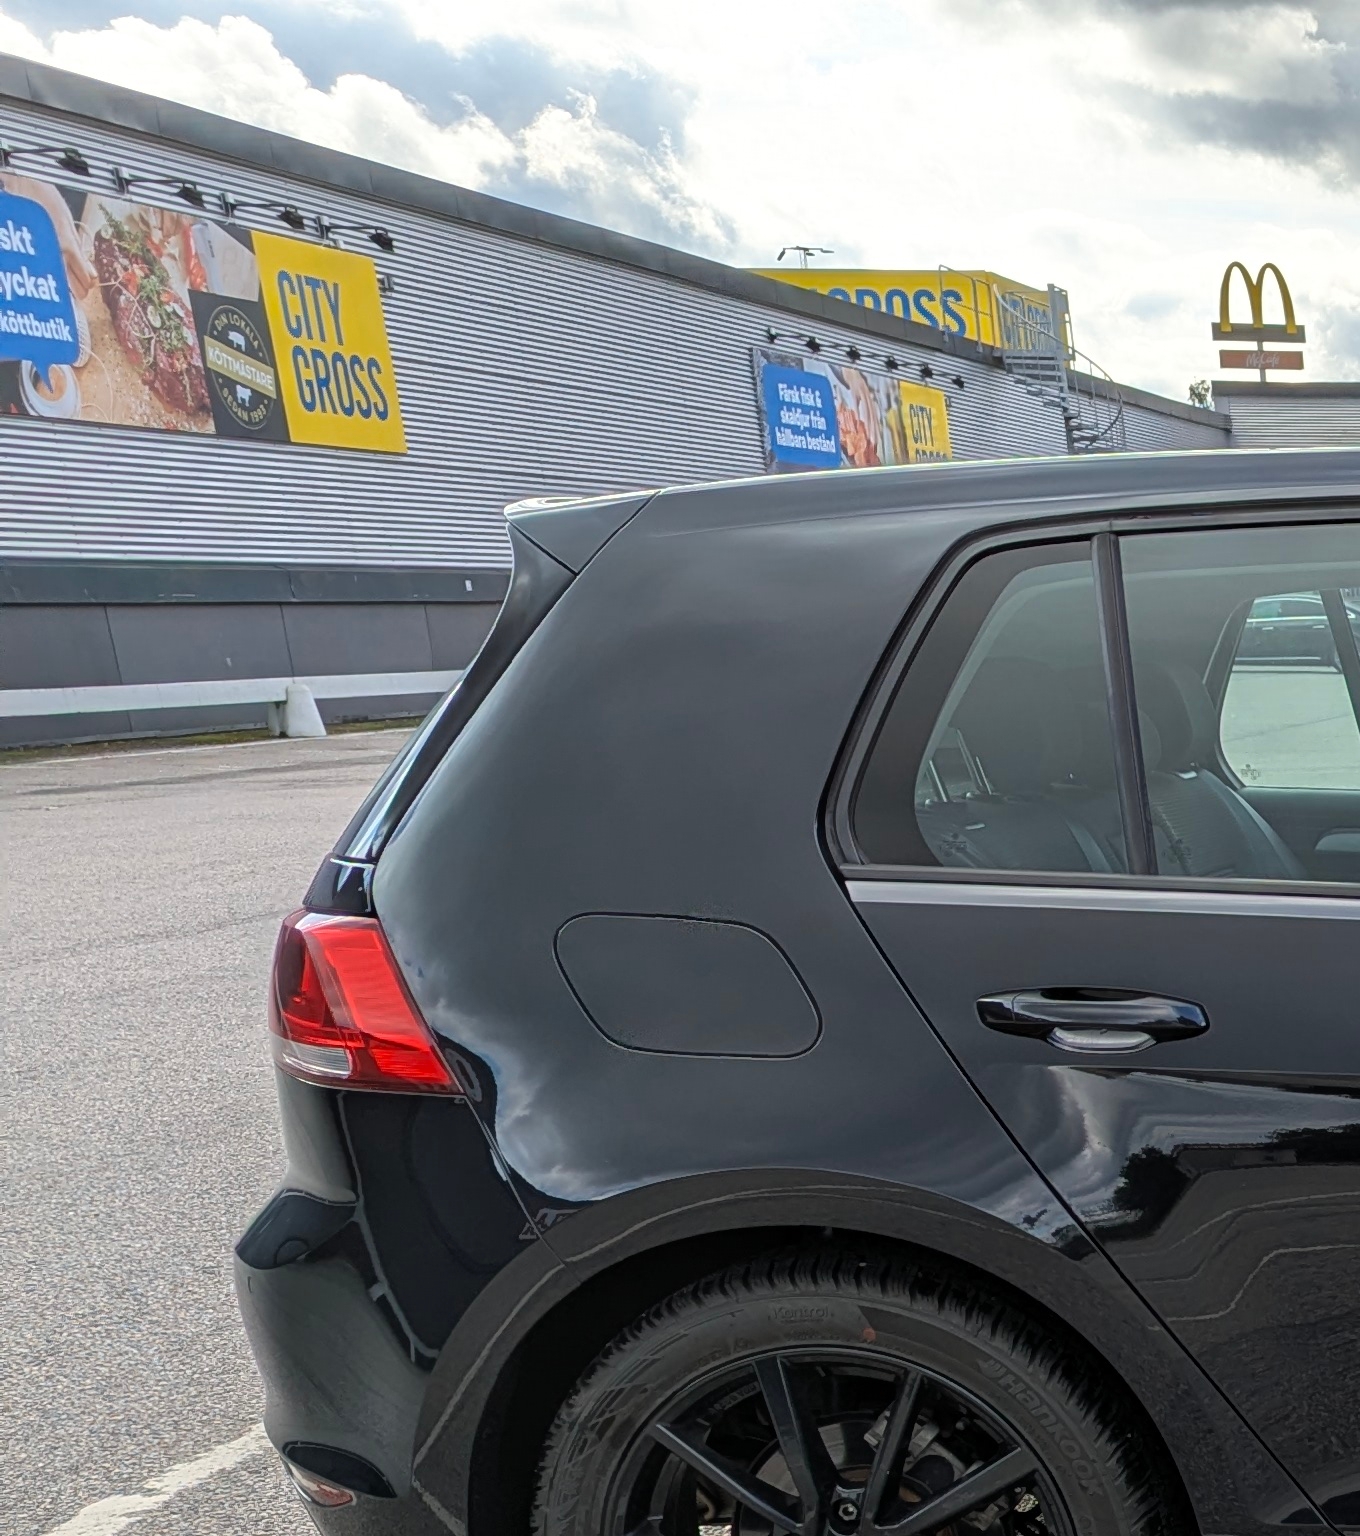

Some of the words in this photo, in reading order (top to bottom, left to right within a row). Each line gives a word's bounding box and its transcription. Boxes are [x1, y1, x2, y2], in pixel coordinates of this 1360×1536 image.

[0, 265, 60, 302] yckat
[277, 270, 344, 346] CITY
[214, 312, 229, 331] DIN
[229, 312, 259, 350] LOKALA
[292, 345, 389, 421] GROSS
[777, 383, 800, 403] Färsk
[800, 386, 815, 405] fisk
[815, 394, 822, 408] &
[780, 406, 810, 431] skaldjur
[810, 410, 827, 430] från
[909, 403, 934, 446] CITY
[775, 426, 807, 449] hållbara
[807, 433, 836, 453] bestånd
[773, 1305, 829, 1320] Kontrol
